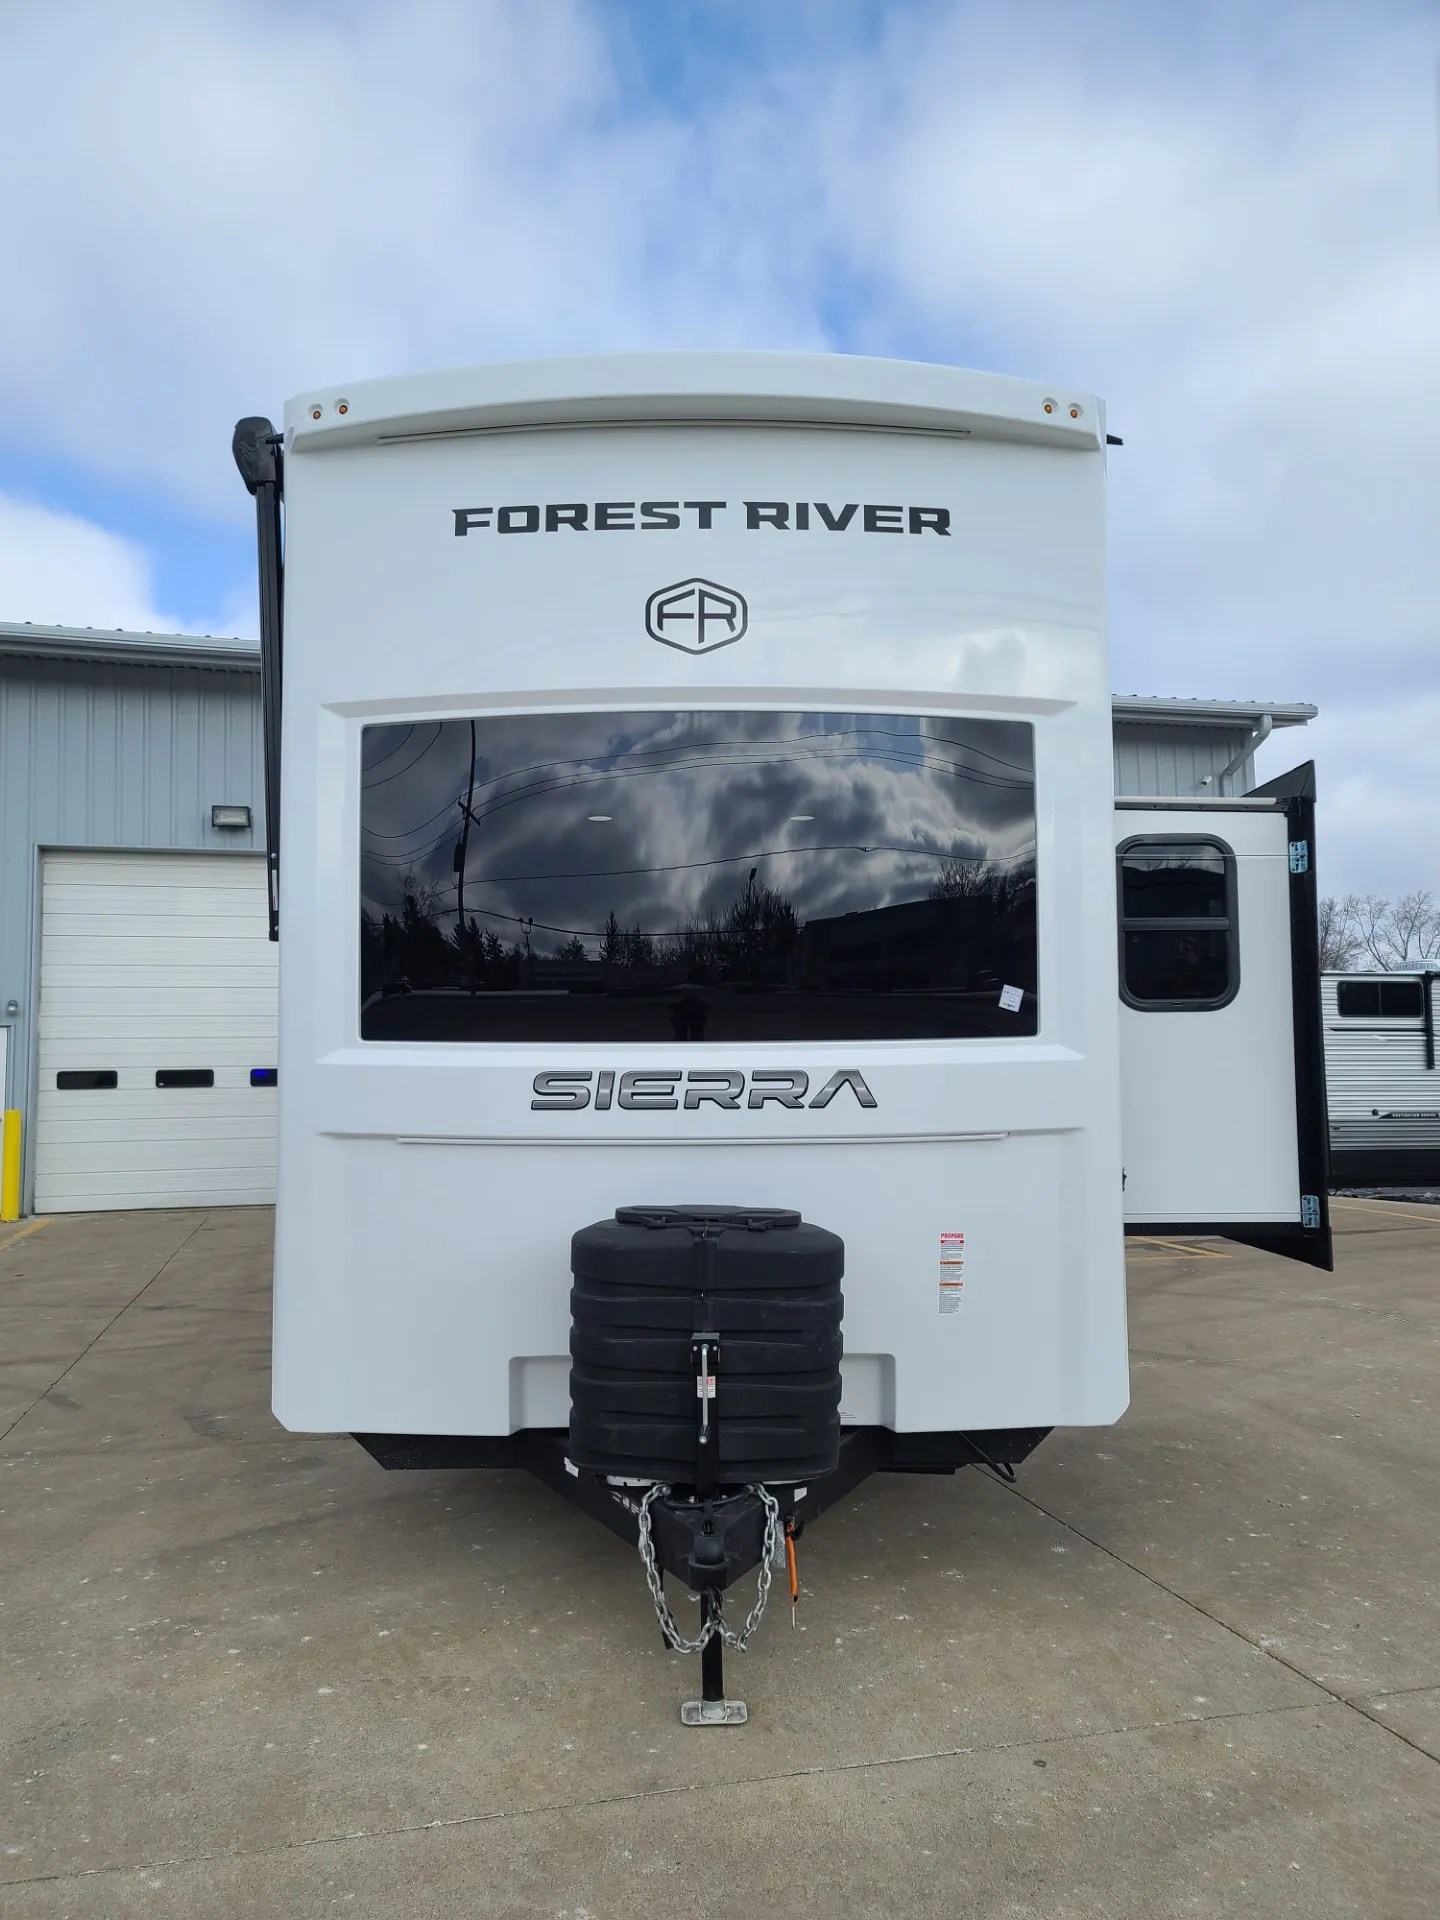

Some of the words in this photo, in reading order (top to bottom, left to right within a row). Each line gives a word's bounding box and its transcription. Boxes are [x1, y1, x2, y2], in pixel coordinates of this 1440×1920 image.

[452, 501, 727, 536] FOREST
[742, 501, 952, 537] RIVER
[656, 587, 738, 645] FR
[530, 1069, 879, 1110] SIERRA
